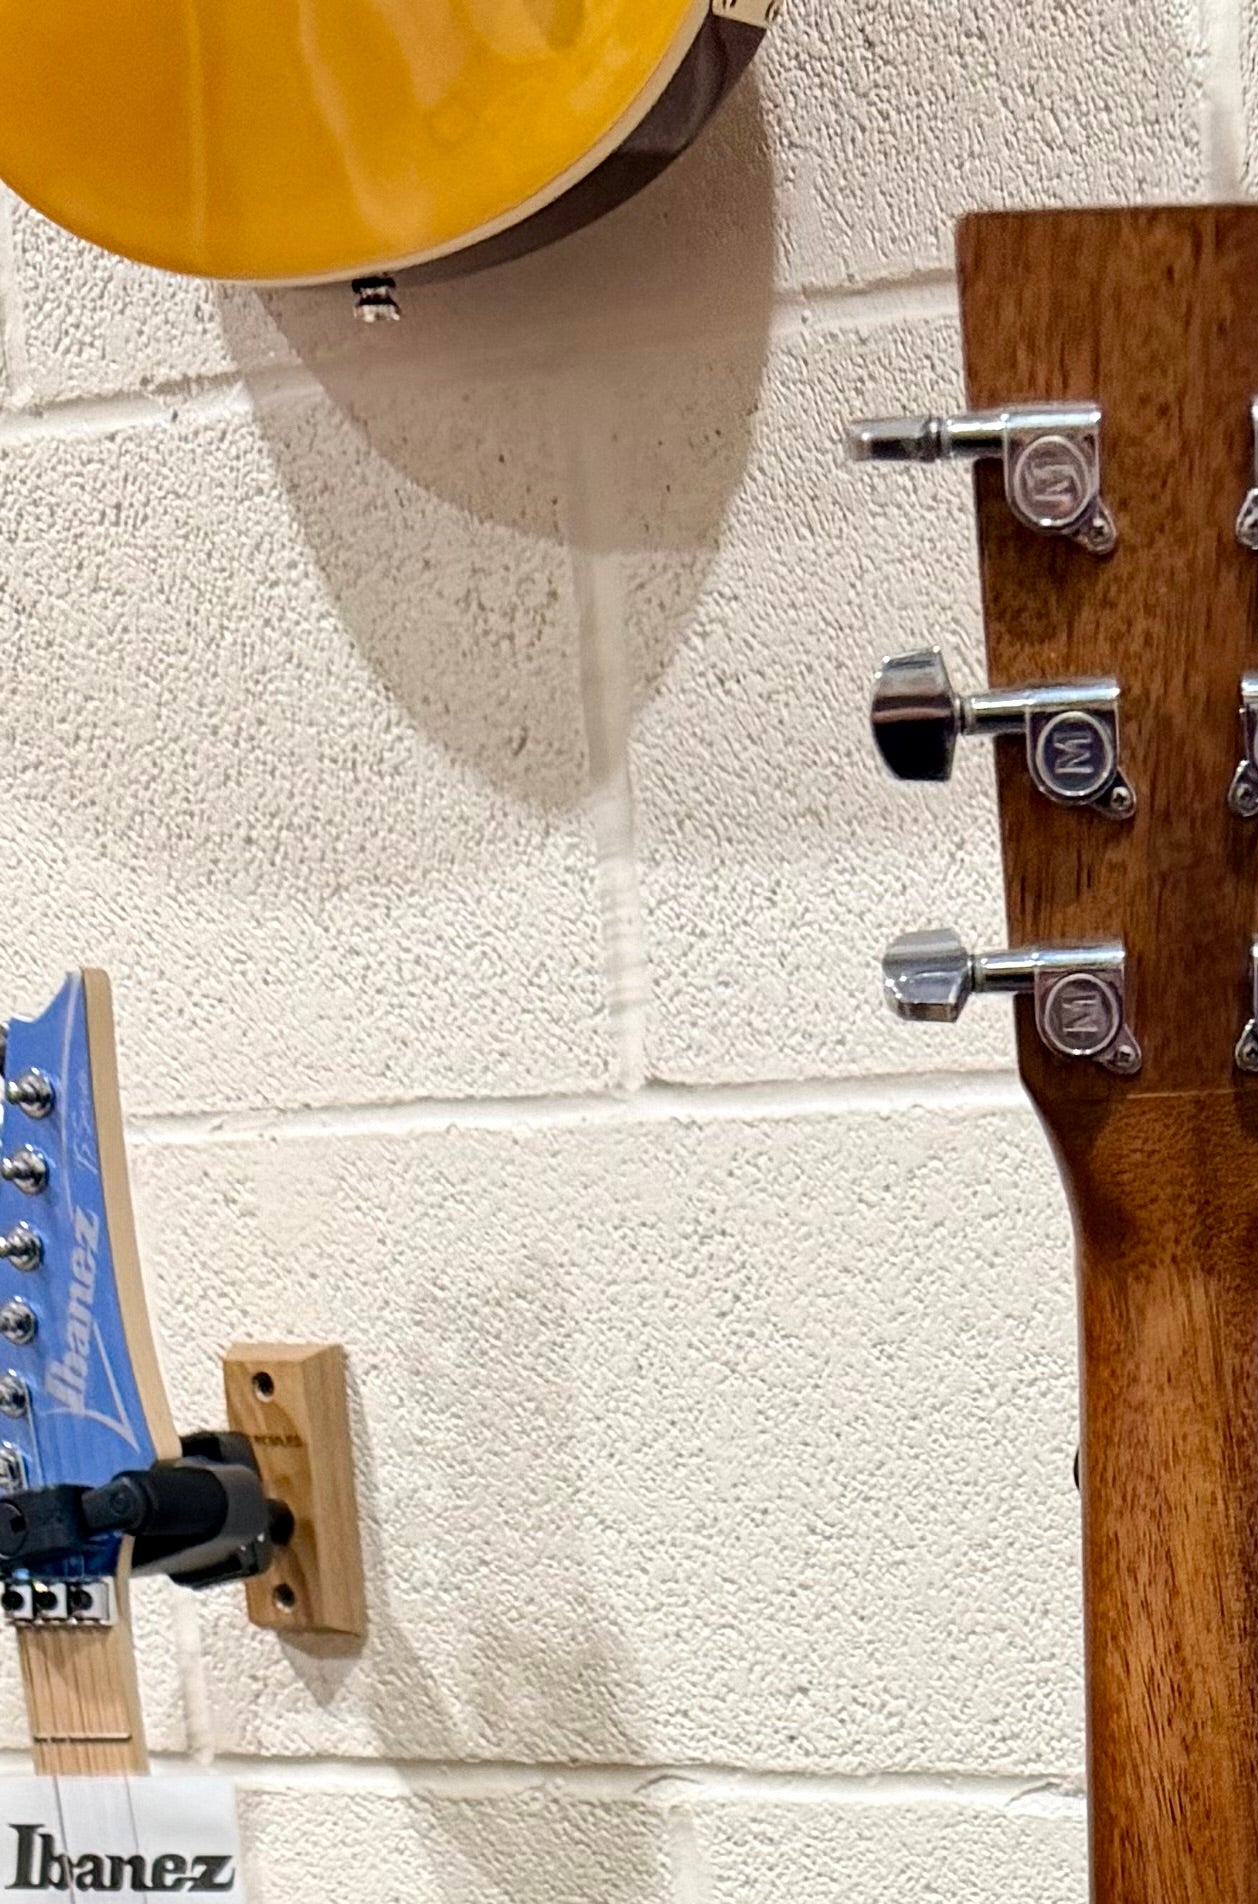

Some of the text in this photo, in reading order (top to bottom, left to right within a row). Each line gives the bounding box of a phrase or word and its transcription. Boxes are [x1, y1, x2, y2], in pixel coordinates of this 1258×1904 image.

[1053, 729, 1093, 774] M
[1063, 990, 1099, 1033] M
[45, 1205, 99, 1418] Ibanez
[4, 1823, 236, 1893] Ibanez
